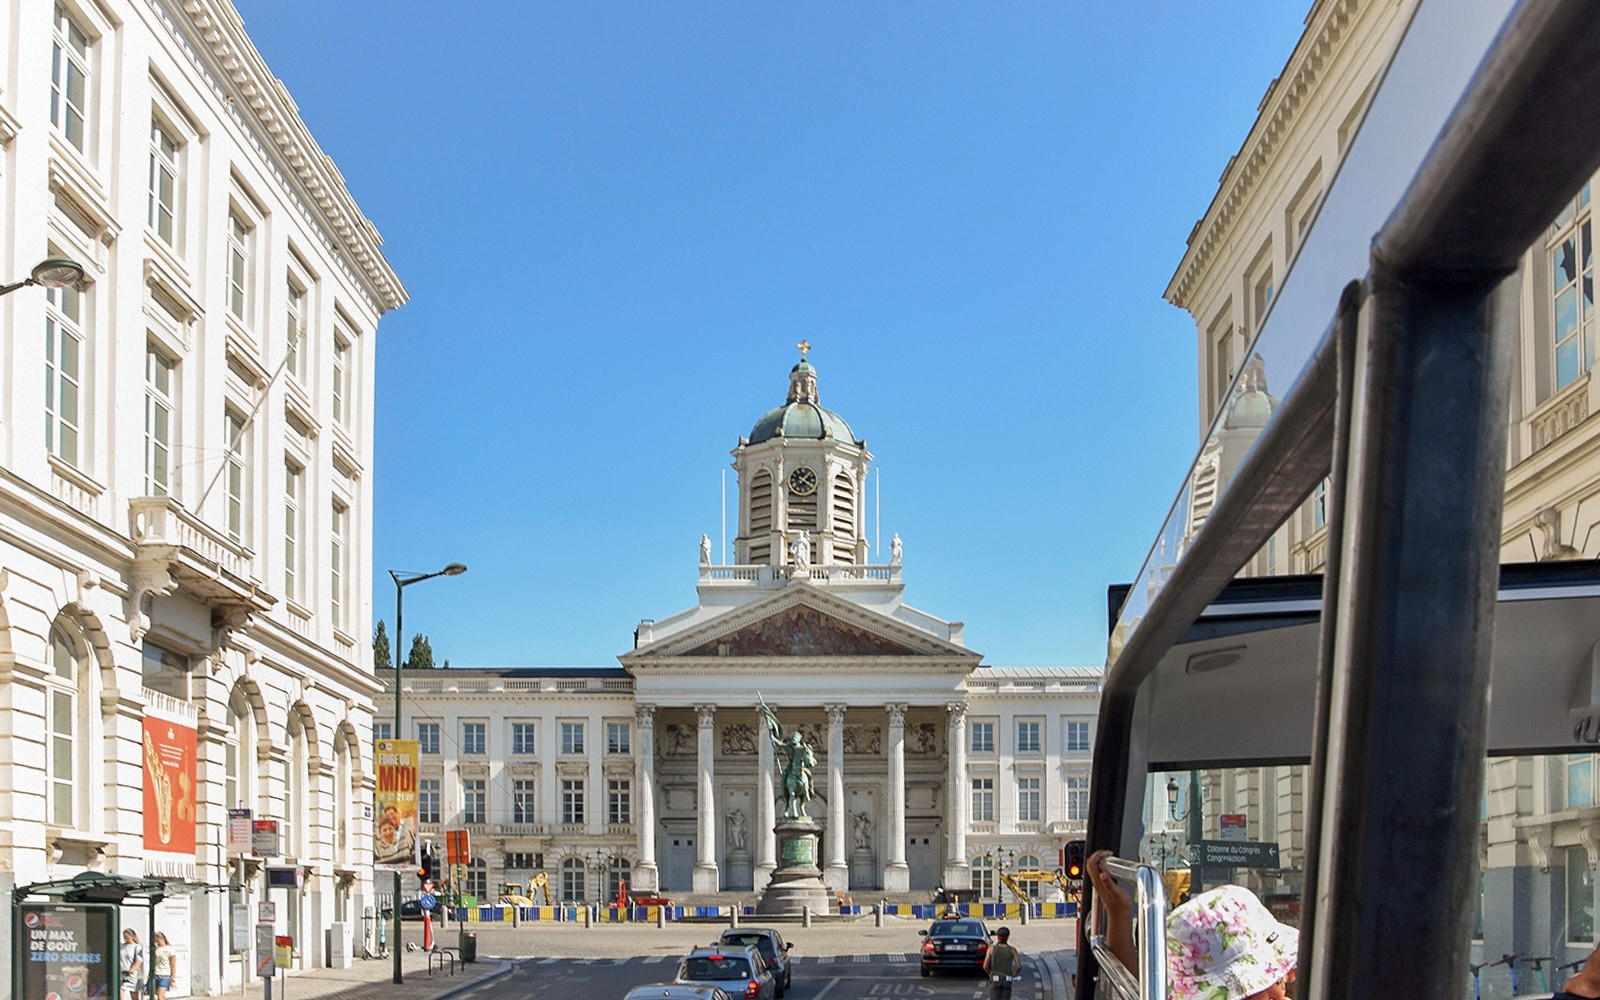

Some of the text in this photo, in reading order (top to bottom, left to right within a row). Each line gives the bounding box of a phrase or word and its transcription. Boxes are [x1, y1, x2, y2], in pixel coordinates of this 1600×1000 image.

[378, 753, 410, 766] FOIRE DU
[379, 766, 416, 792] MIDI
[30, 930, 74, 940] UN MAX
[30, 941, 45, 950] DE
[61, 953, 101, 963] SUCRES
[870, 983, 936, 996] BUS
